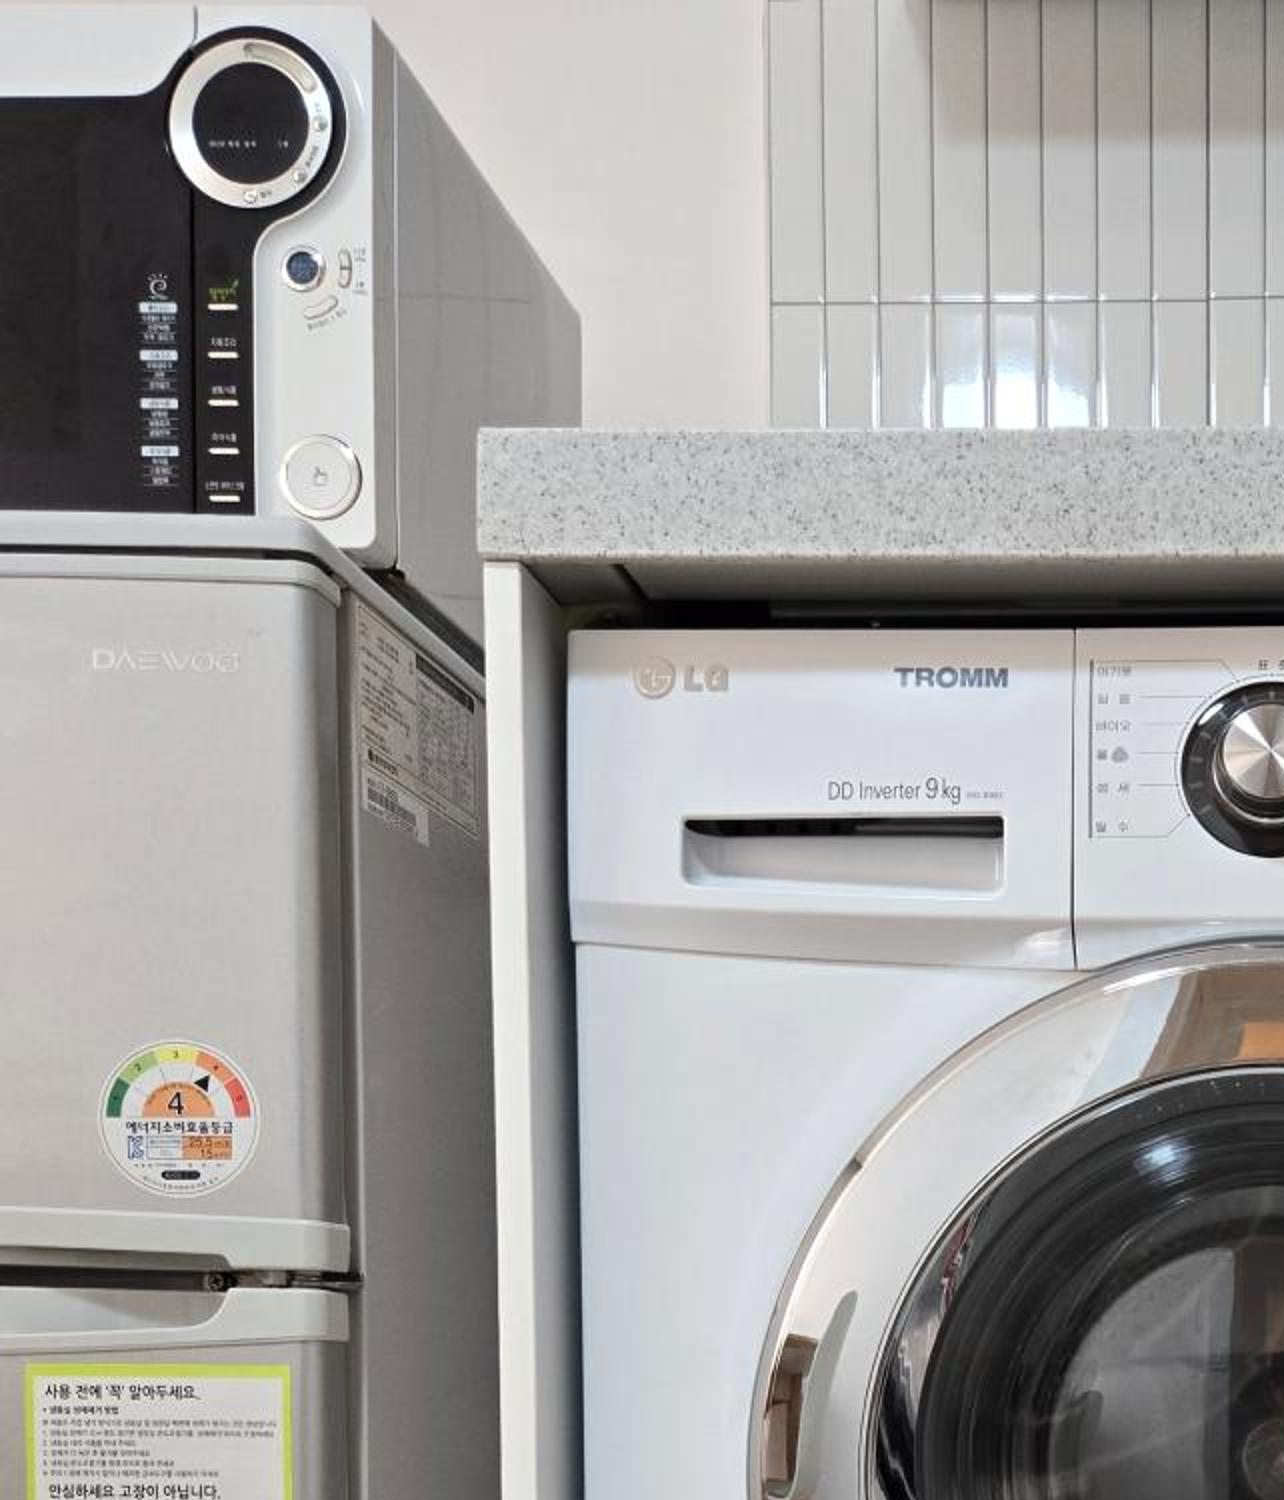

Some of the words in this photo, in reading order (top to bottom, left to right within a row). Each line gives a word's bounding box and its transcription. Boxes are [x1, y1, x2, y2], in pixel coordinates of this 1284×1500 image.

[684, 664, 729, 692] LG
[894, 667, 1009, 689] TROMM
[827, 781, 854, 801] DD
[859, 781, 921, 801] Inverter
[167, 1091, 184, 1115] 4
[126, 1121, 234, 1135] 에너지소비효율등급
[45, 1384, 71, 1400] 사용
[75, 1384, 102, 1400] 전에
[49, 1483, 114, 1499] 안심하세요
[119, 1484, 159, 1500] 고장이
[163, 1485, 221, 1500] 아닙니다.
